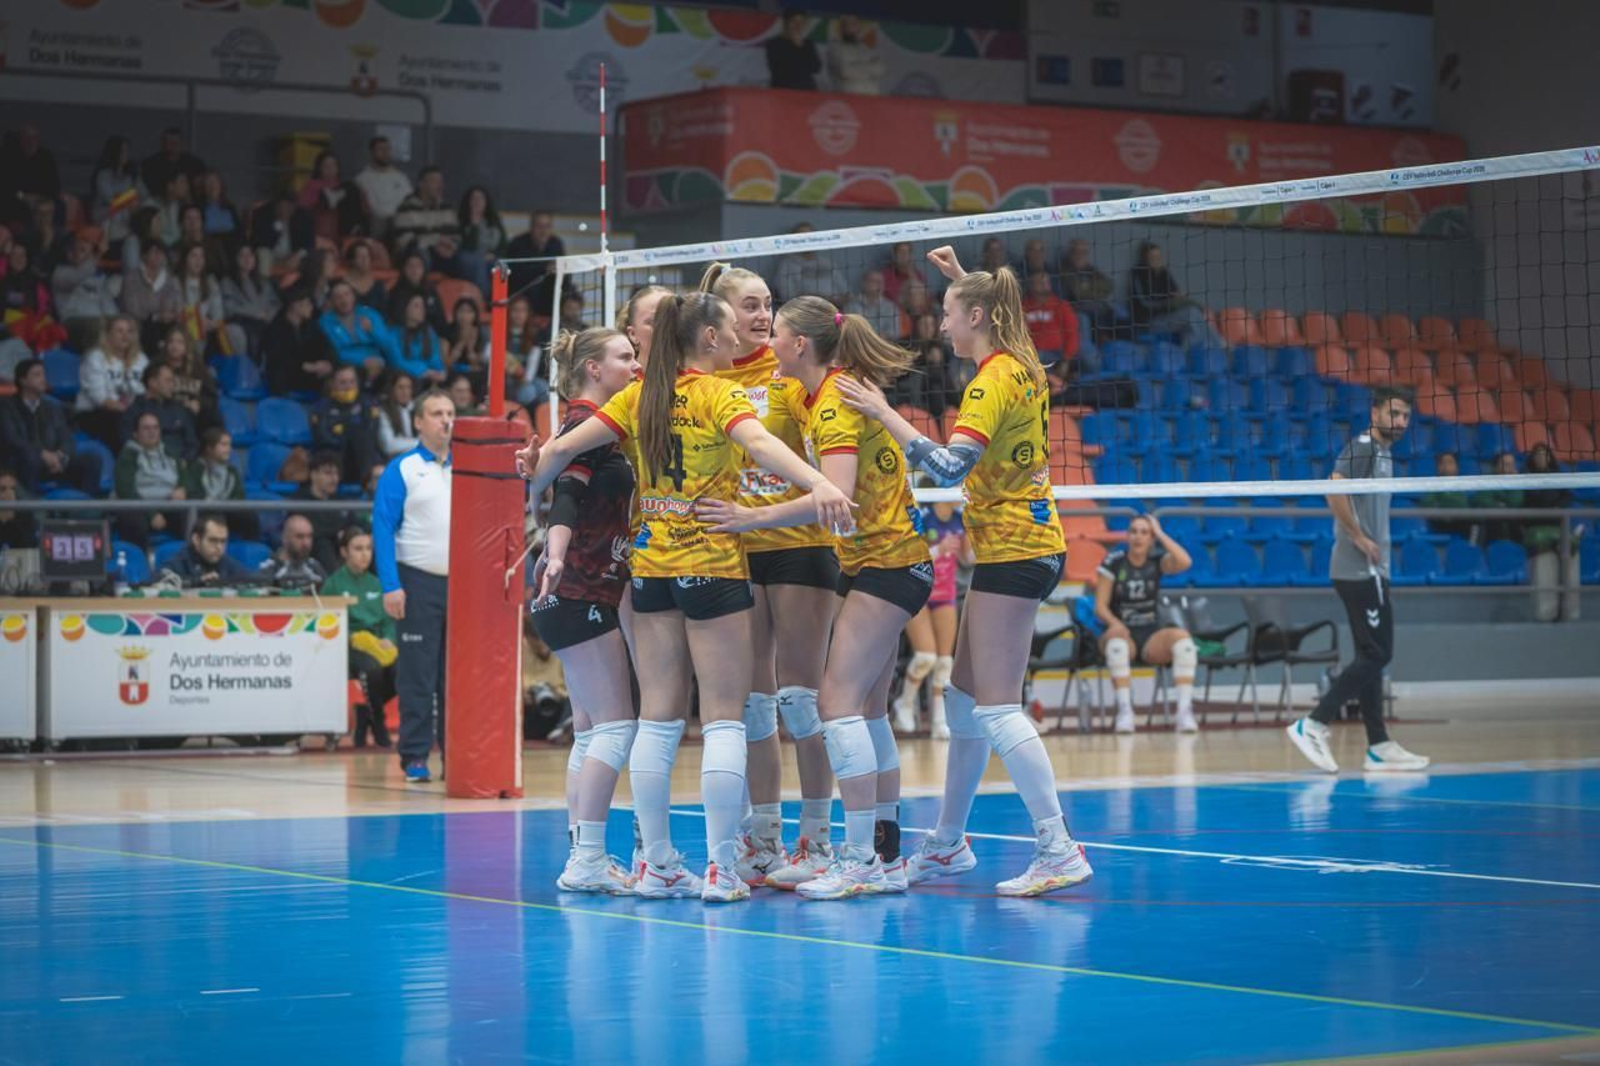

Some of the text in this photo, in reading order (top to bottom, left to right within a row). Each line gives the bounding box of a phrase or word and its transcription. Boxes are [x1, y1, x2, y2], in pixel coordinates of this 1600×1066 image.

[588, 604, 602, 623] 4
[169, 652, 292, 671] Ayuntamiento de
[170, 673, 292, 690] Dos Hermanas
[170, 695, 210, 705] Deportes
